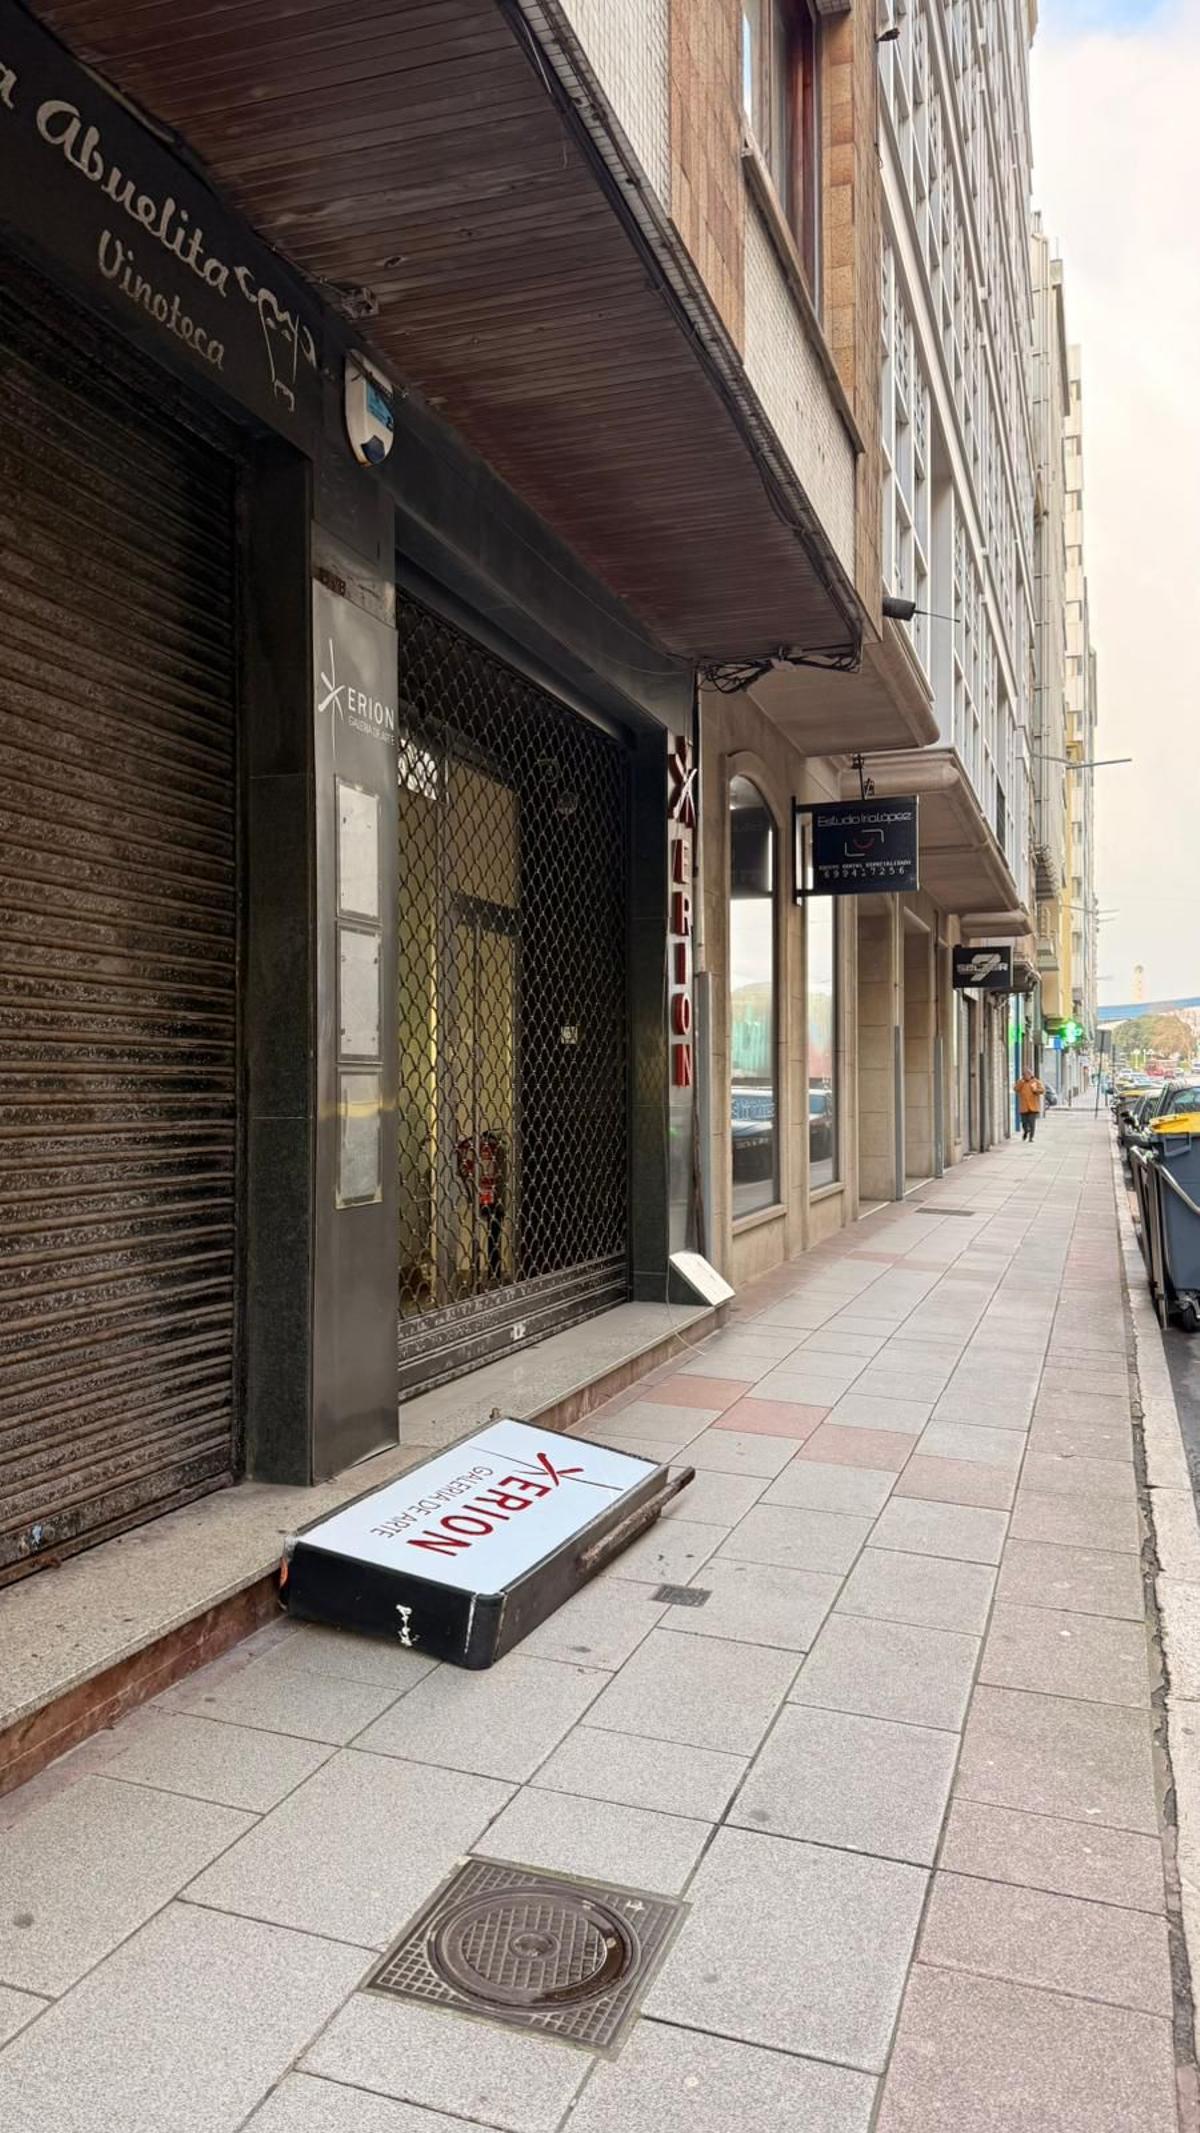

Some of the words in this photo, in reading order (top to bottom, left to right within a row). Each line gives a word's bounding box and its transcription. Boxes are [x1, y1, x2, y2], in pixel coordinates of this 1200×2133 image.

[36, 100, 230, 298] Abuelita
[99, 229, 225, 371] Vinoteca
[318, 656, 394, 744] XERION
[668, 735, 698, 1088] XERION
[371, 1511, 418, 1539] ARTE
[406, 1452, 590, 1557] XERION
[409, 1498, 441, 1517] DE
